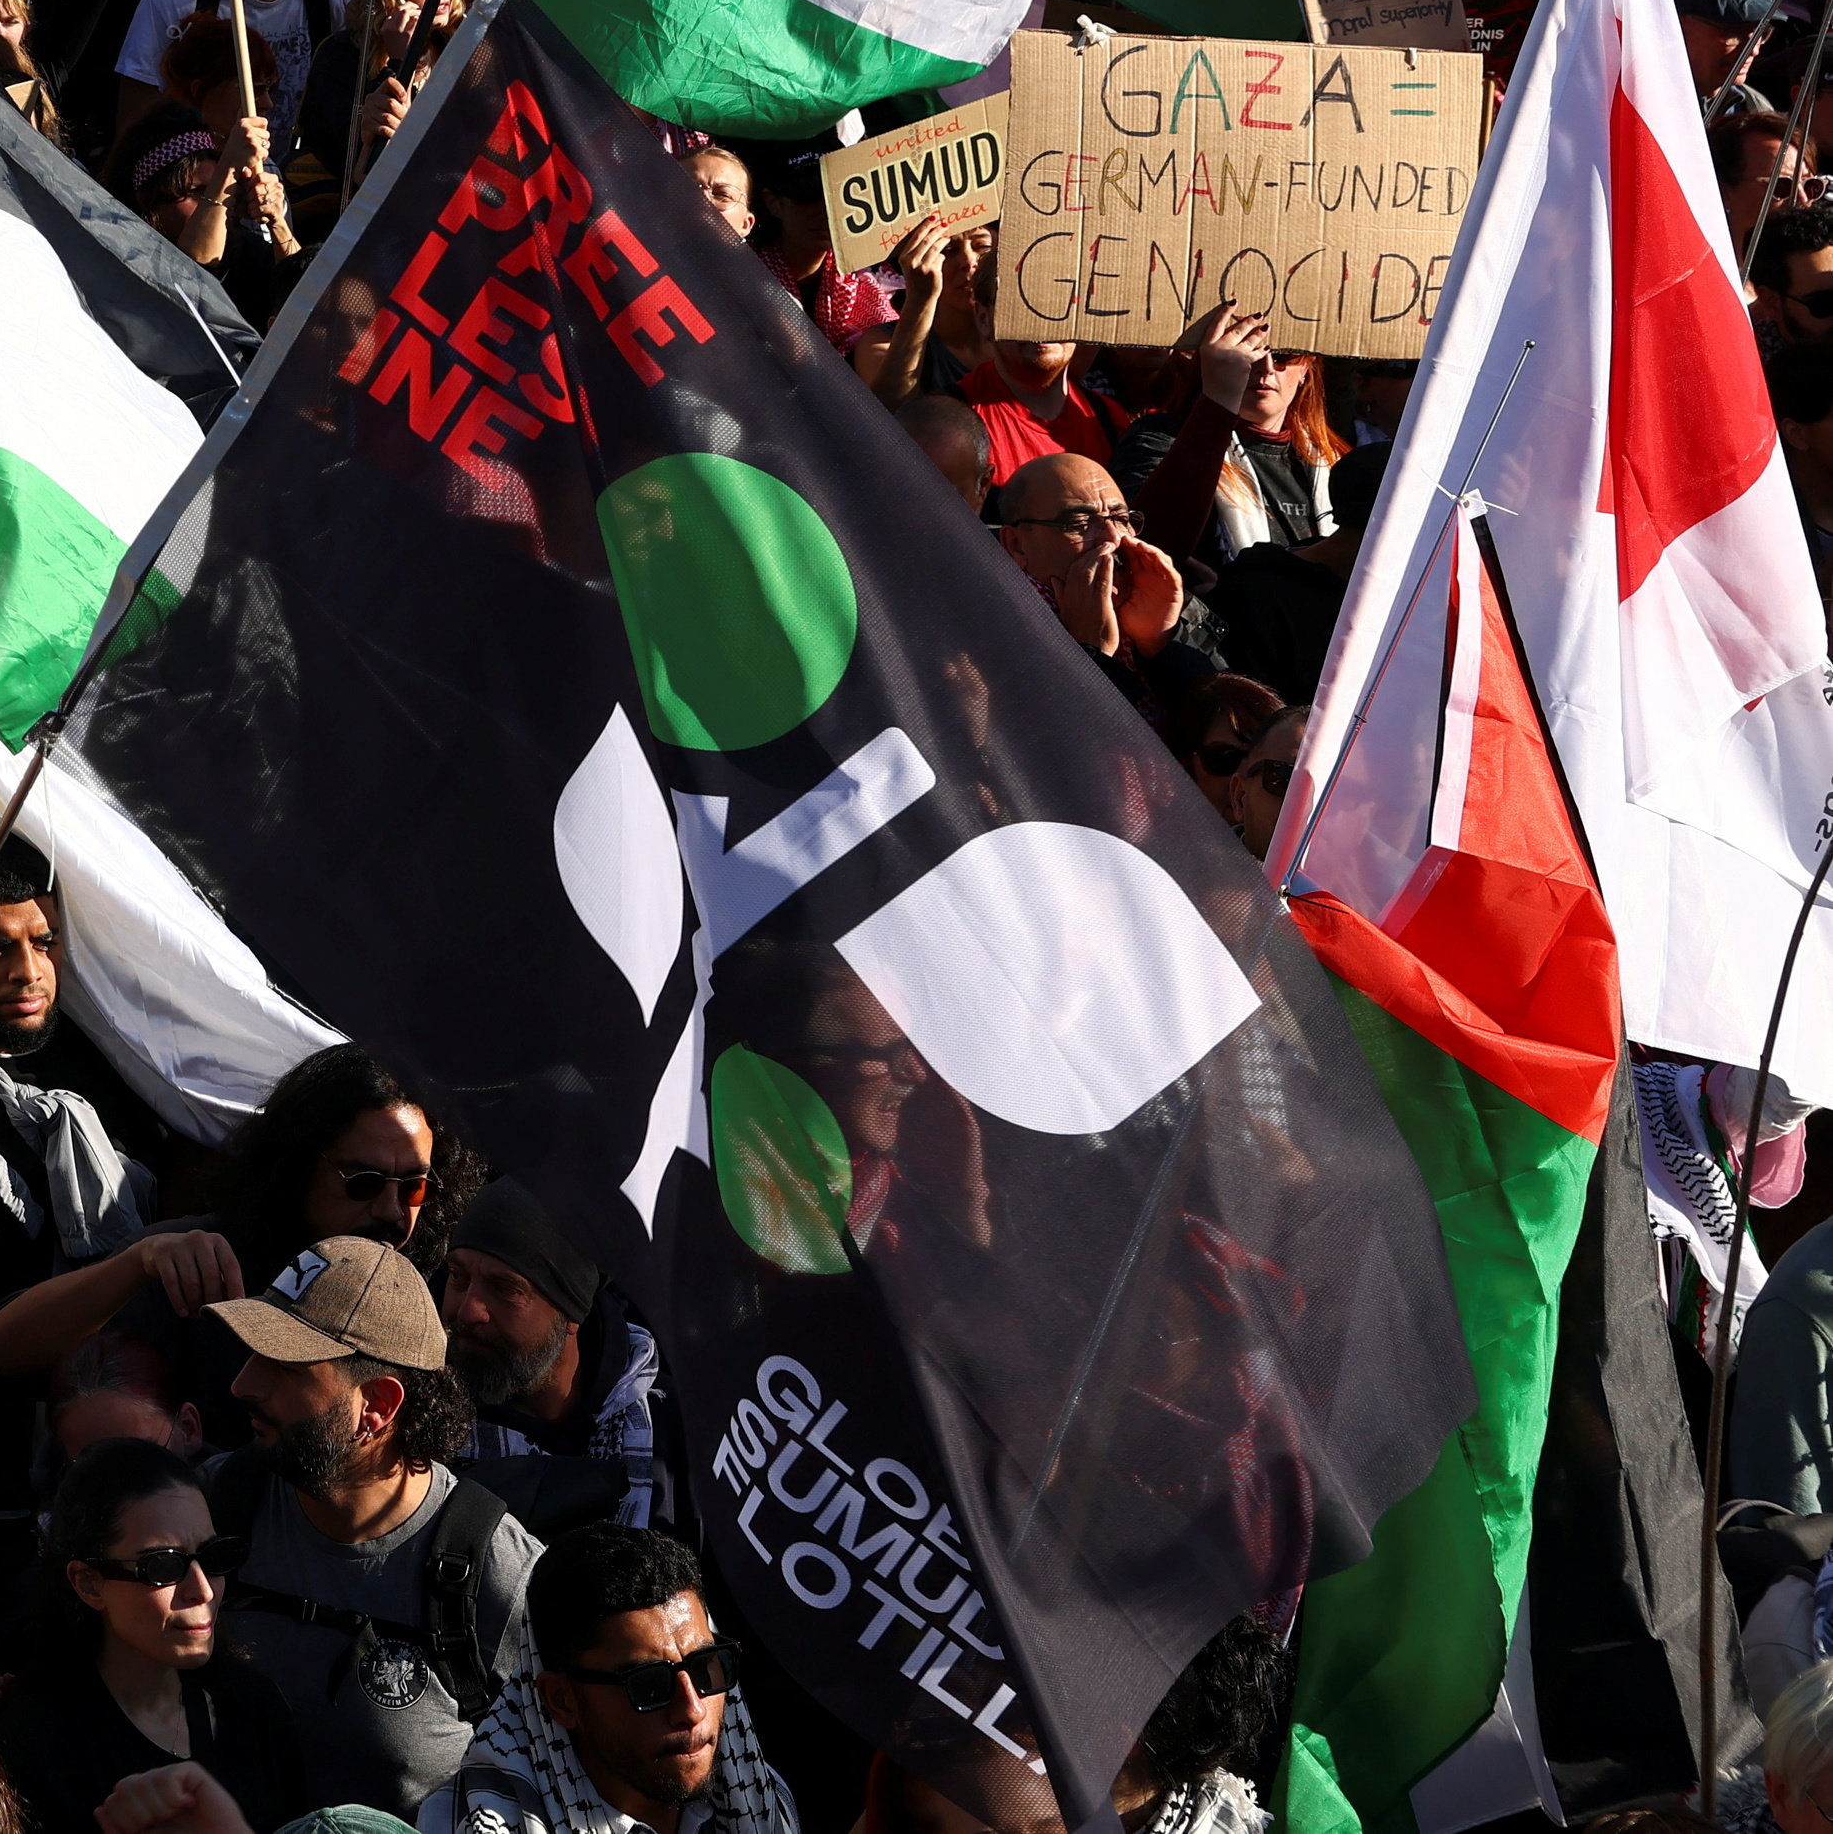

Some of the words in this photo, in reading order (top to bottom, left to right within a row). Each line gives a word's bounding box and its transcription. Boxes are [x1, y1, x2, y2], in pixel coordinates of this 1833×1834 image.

[1319, 6, 1375, 40] moral
[1101, 44, 1367, 139] GAZA
[1389, 81, 1439, 118] =
[870, 115, 967, 161] united
[842, 131, 1001, 235] SUMUD
[1019, 146, 1469, 218] GERMAN-FUNDED
[712, 1432, 1049, 1777] FLOTILL
